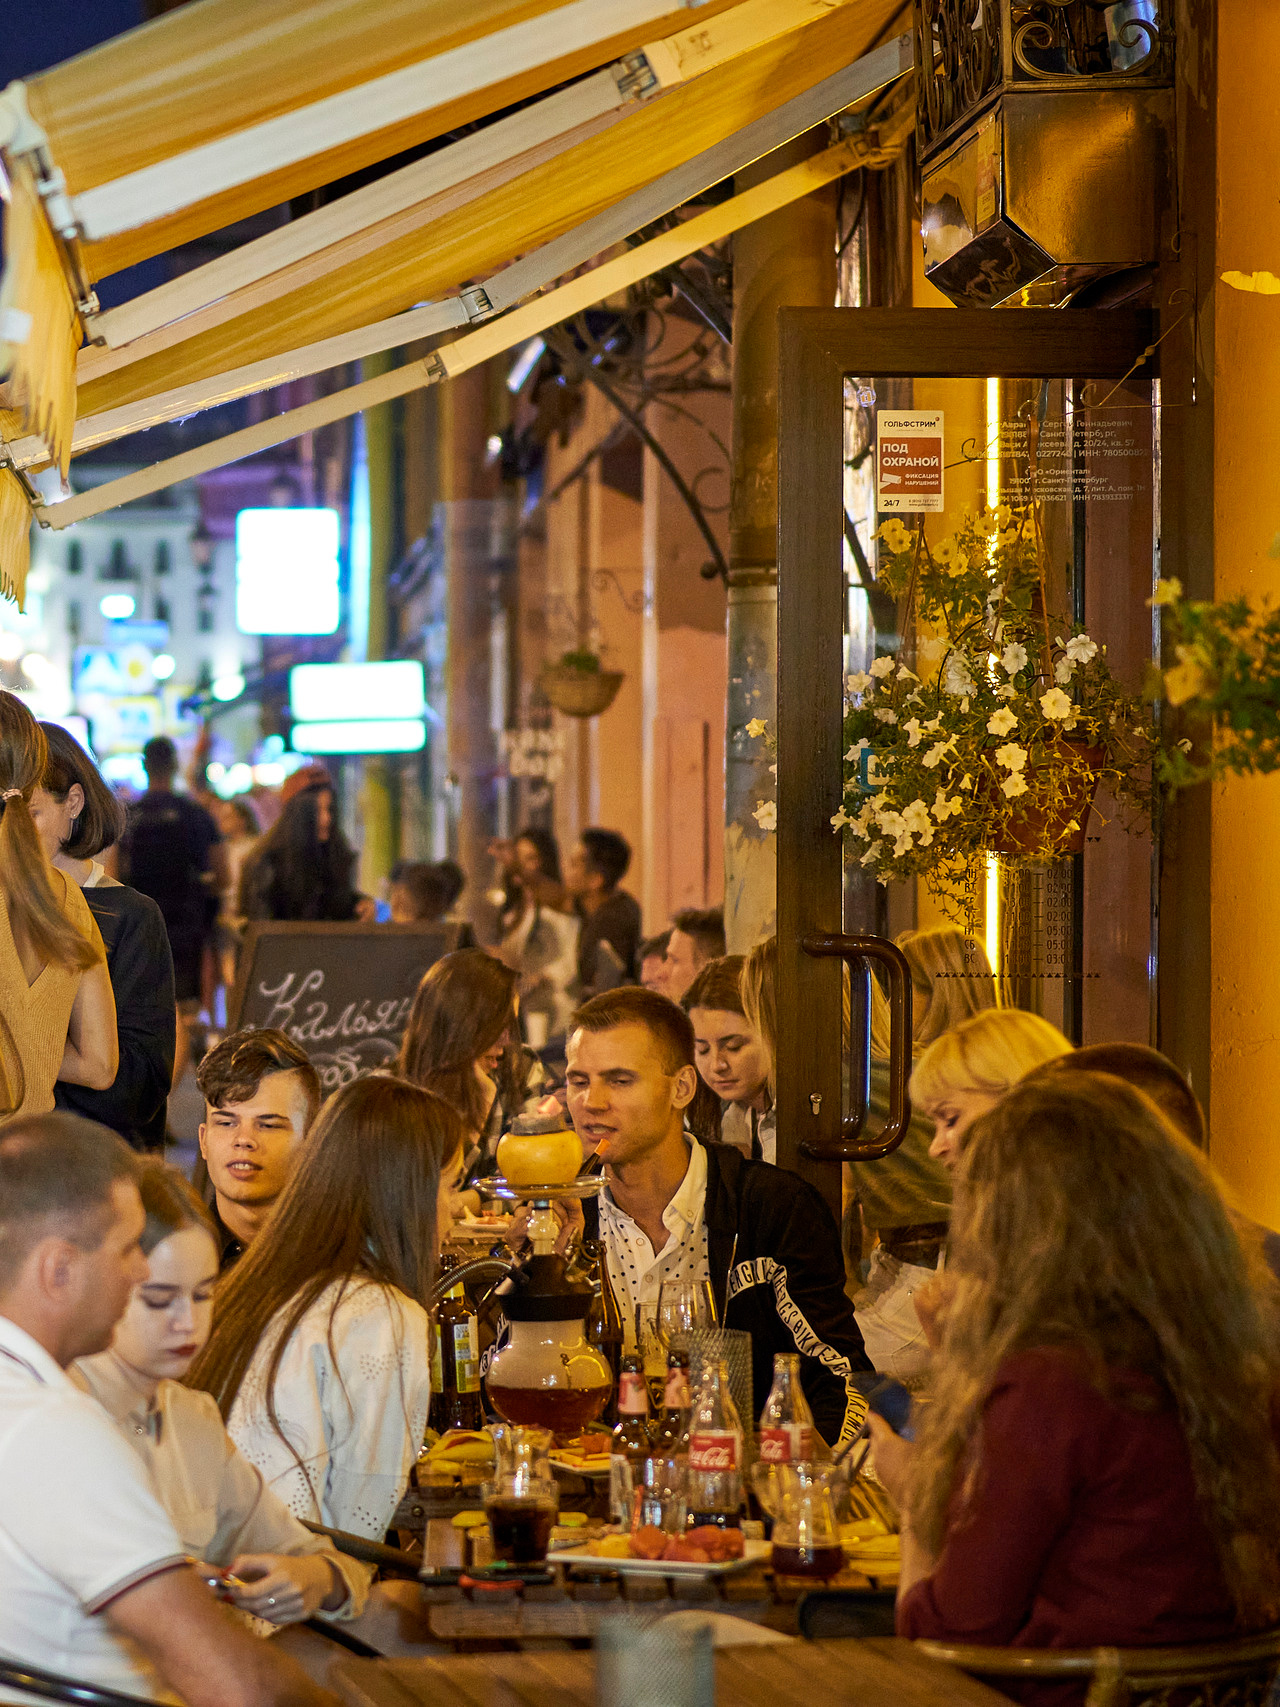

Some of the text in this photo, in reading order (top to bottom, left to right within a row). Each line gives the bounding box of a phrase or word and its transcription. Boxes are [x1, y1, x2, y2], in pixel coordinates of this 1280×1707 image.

[883, 420, 936, 428] ГОЛЬФСТРИМ
[882, 443, 909, 454] ПОД
[882, 455, 939, 467] ОХРАНОЙ
[883, 499, 900, 507] 24/7
[964, 939, 975, 950] СБ
